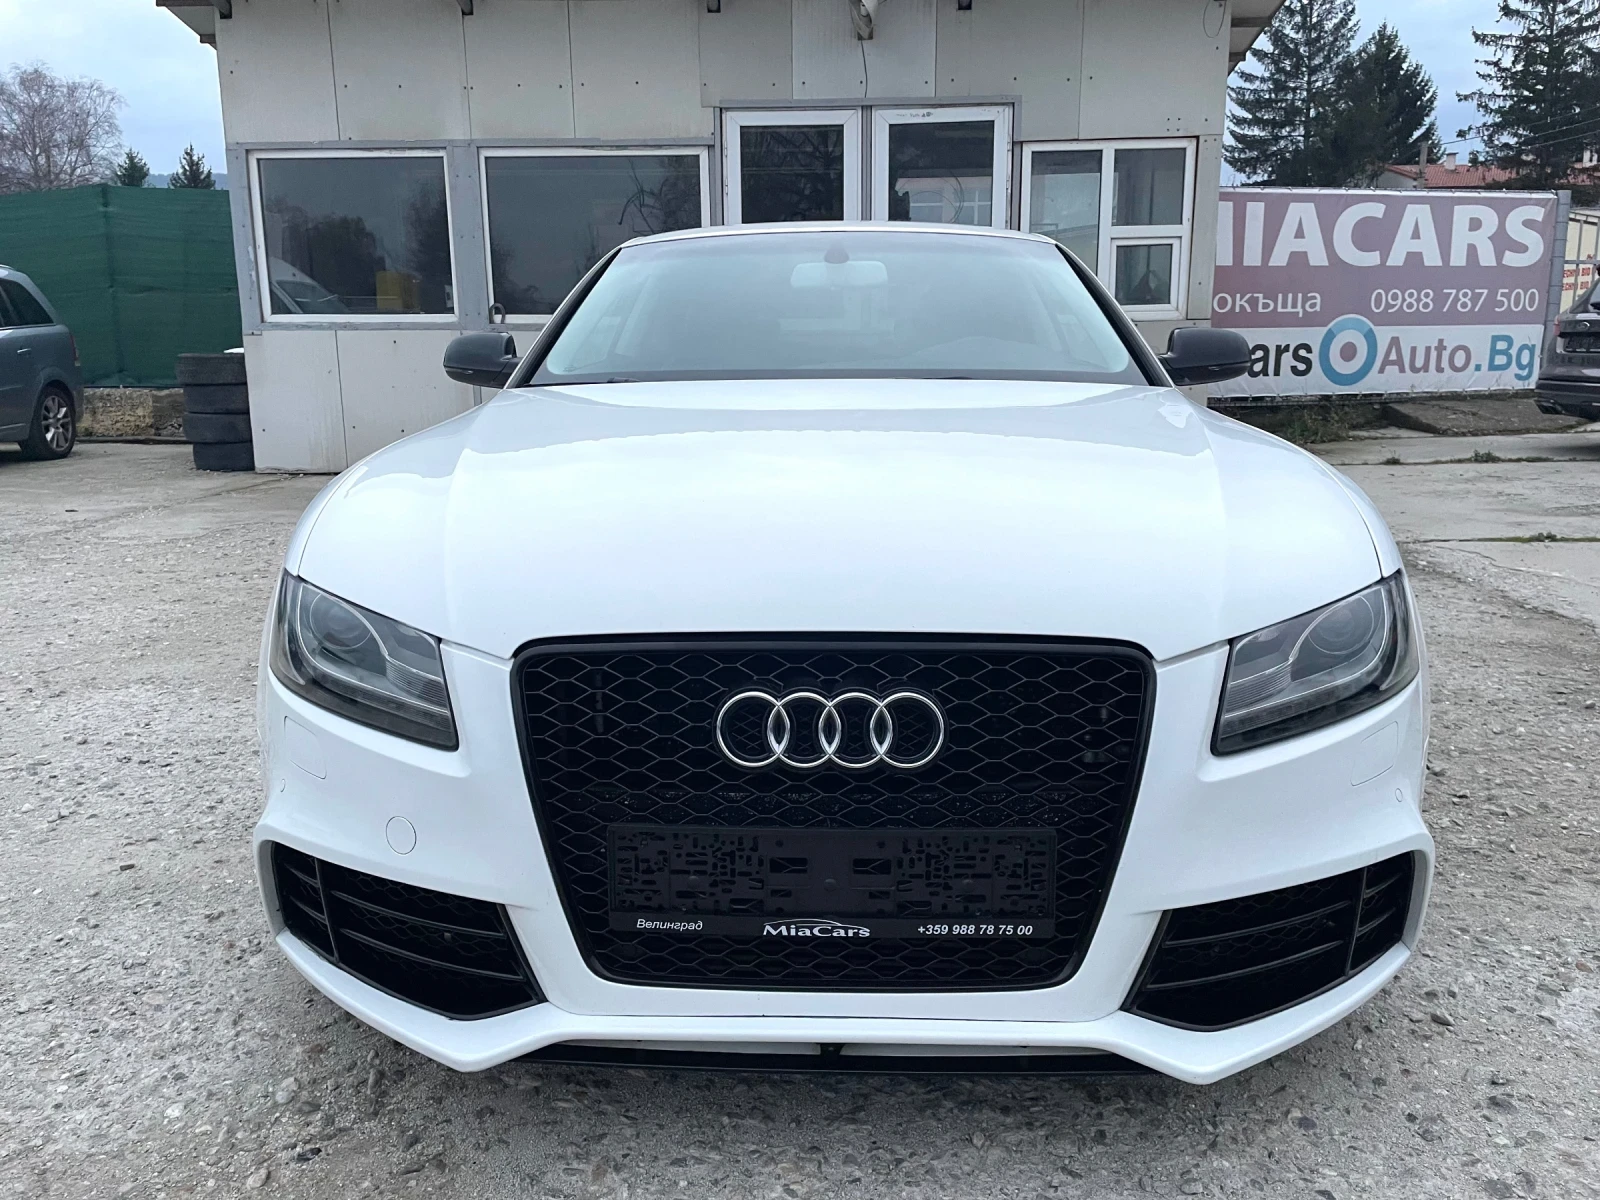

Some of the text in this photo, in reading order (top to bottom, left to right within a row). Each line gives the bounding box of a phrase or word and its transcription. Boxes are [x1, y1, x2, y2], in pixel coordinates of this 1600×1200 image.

[1370, 288, 1540, 313] 0988 787 500
[636, 918, 704, 931] Велинград
[917, 924, 1034, 936] +359 988 78 75 00
[763, 925, 871, 938] MiaCars
